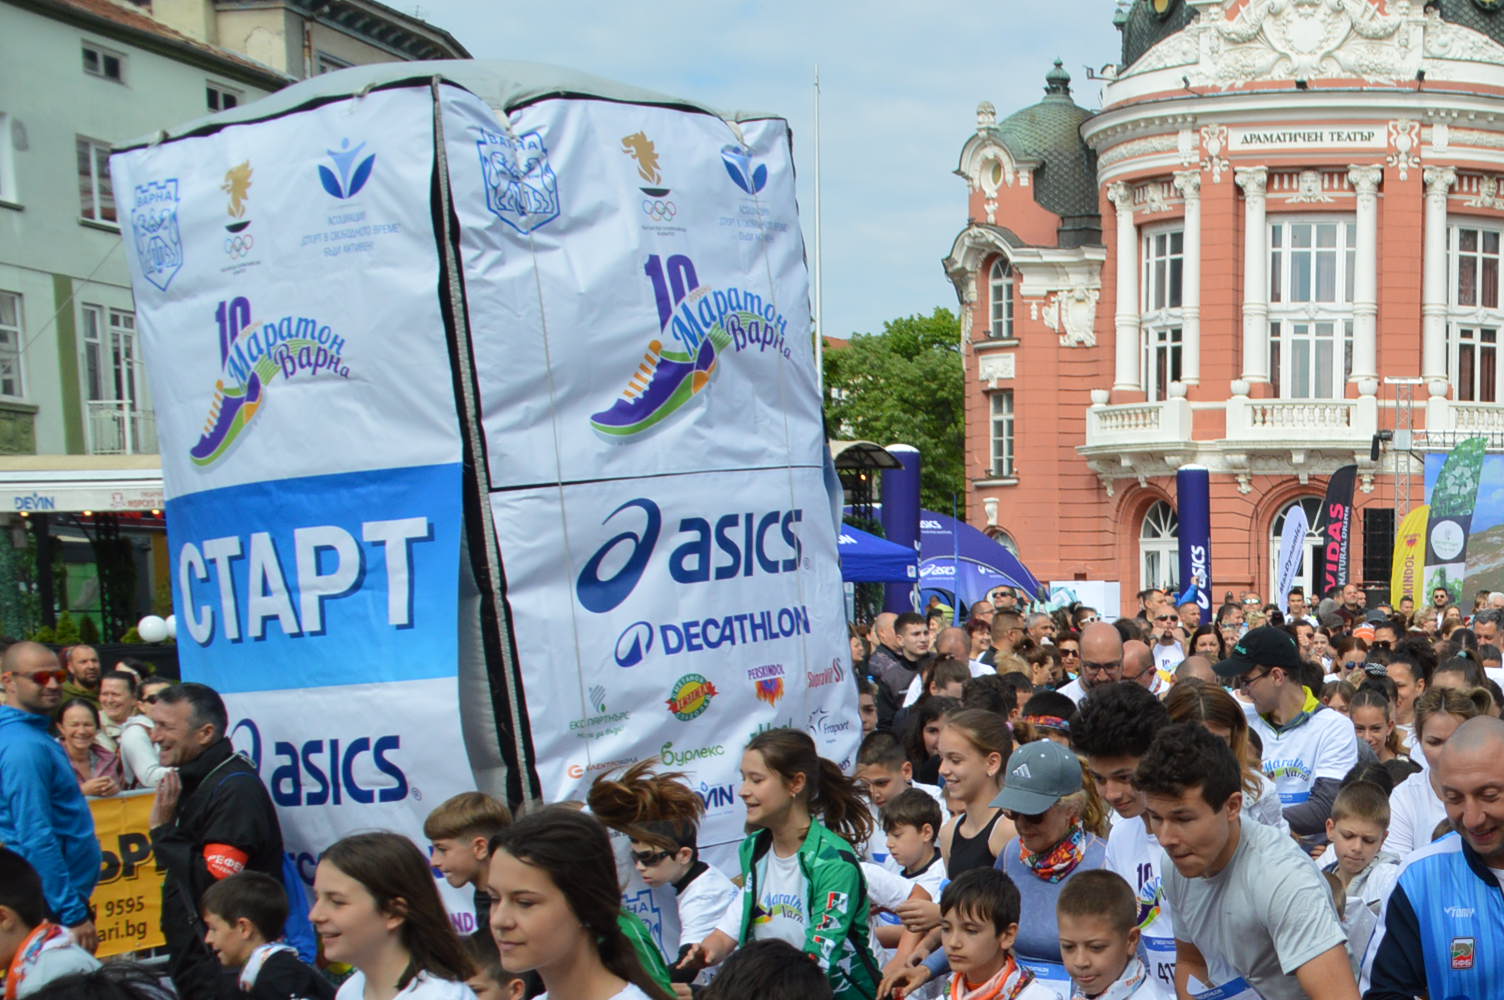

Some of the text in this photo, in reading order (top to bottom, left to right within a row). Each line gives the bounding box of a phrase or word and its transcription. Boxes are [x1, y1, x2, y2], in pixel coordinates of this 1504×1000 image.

[1240, 131, 1375, 145] ДРАМАТИЧЕН ТЕАТЪР
[644, 254, 700, 334] 10
[215, 296, 252, 373] 10
[671, 287, 788, 358] Маратон
[726, 313, 792, 360] Варна
[228, 315, 347, 392] Маратон
[274, 343, 351, 380] Варна
[14, 494, 55, 510] DEVIN
[669, 509, 803, 584] asics
[1323, 502, 1345, 593] VIDAS
[1337, 538, 1348, 586] NATURAL
[179, 516, 430, 645] СТАРТ
[1402, 554, 1415, 599] KINDOL
[660, 605, 811, 655] DECATHLON
[271, 735, 408, 807] asics
[98, 919, 148, 943] ari.bg
[105, 896, 145, 918] 9595
